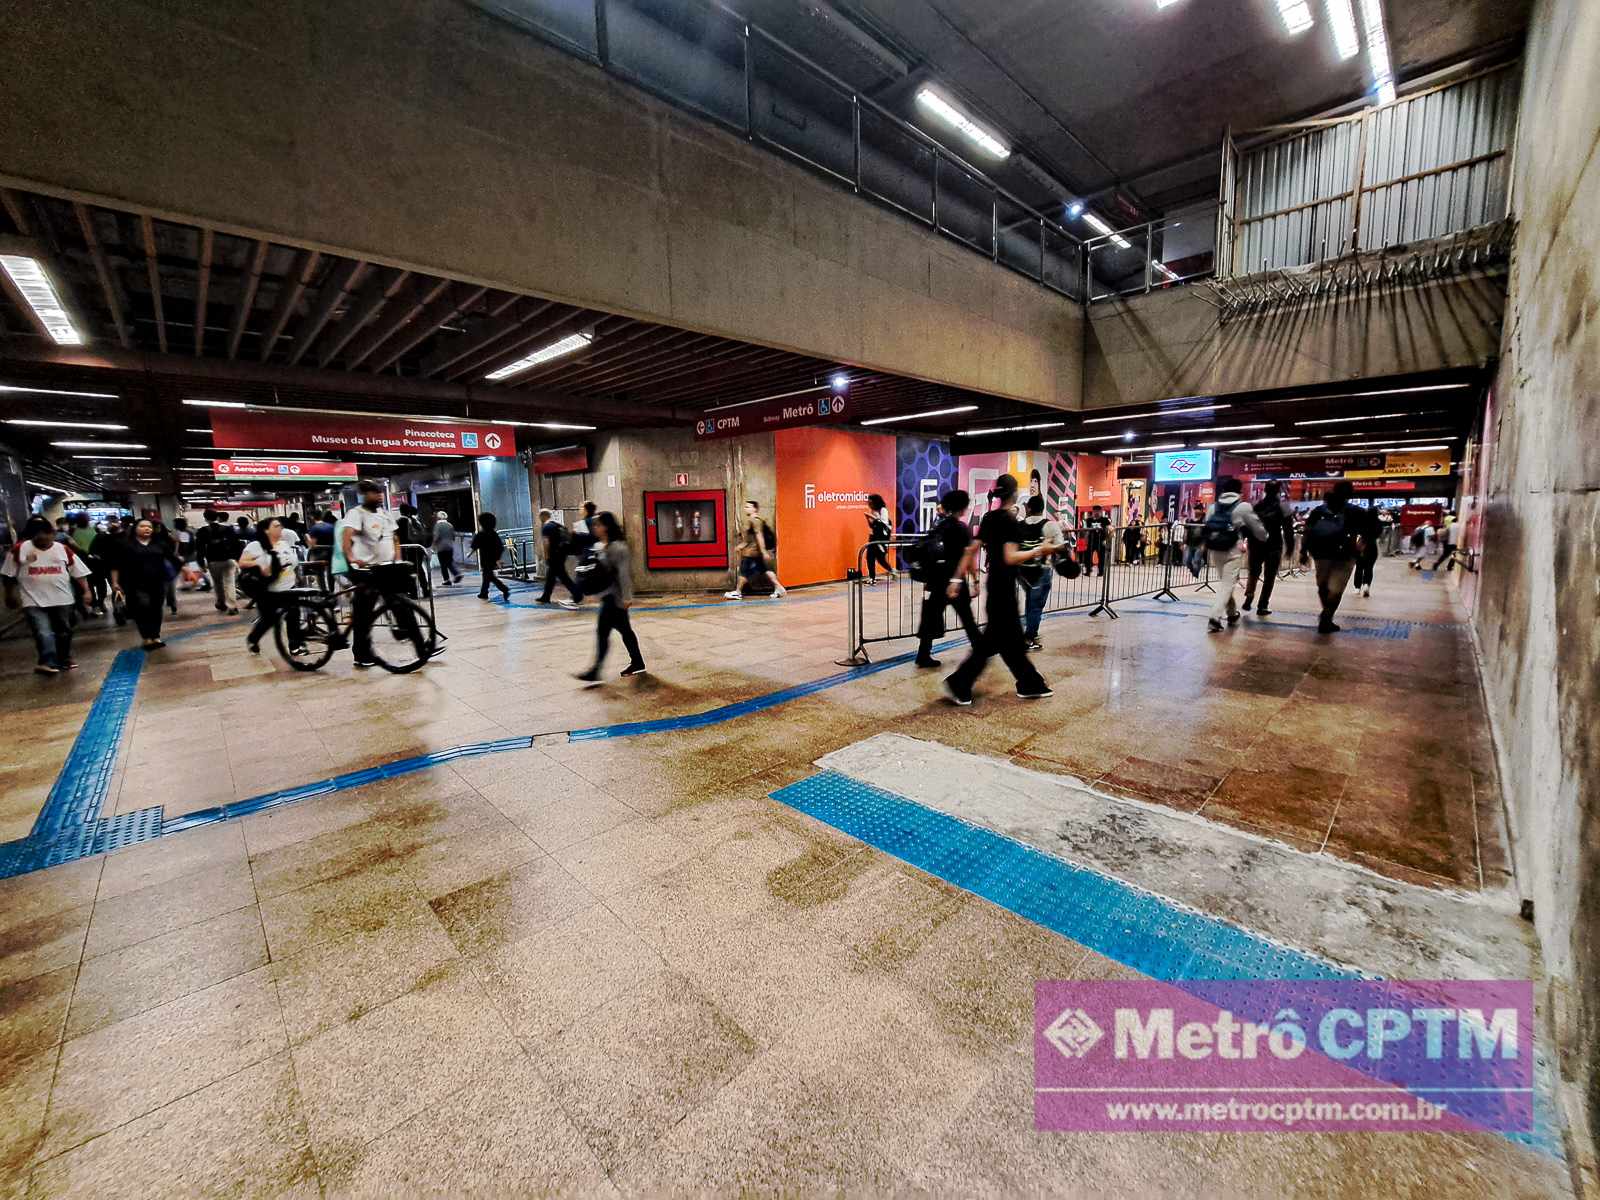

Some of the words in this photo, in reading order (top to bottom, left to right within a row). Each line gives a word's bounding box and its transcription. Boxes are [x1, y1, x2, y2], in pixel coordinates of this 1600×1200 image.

[783, 403, 814, 419] Metrô
[717, 416, 740, 430] CPTM
[405, 429, 455, 438] Pinacoteca
[312, 435, 348, 444] Museu
[350, 436, 364, 444] da
[403, 439, 456, 449] Portuguesa
